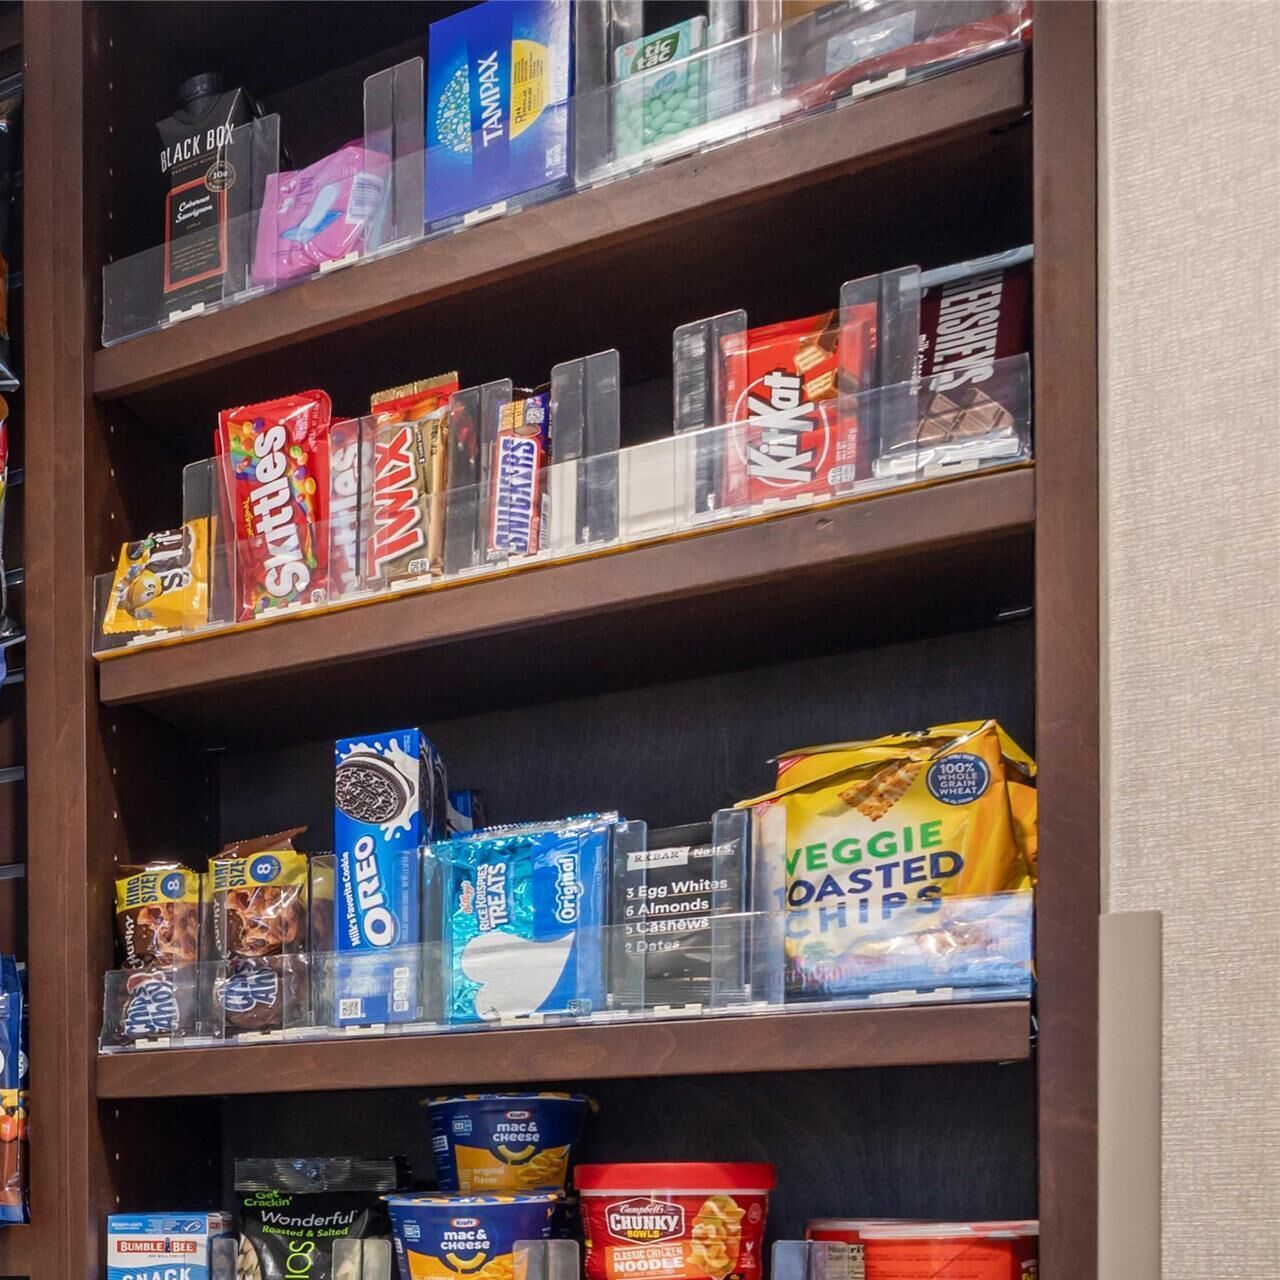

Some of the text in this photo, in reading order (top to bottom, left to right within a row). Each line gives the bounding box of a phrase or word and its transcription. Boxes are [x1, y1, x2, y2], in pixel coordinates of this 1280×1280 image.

[645, 38, 672, 58] tic
[637, 52, 671, 69] tac
[478, 50, 503, 147] TAMPAX
[160, 123, 235, 173] BLACK BOX
[366, 428, 422, 578] TWIX
[509, 440, 536, 554] SNICKERS
[250, 425, 310, 596] Skittles
[938, 772, 977, 781] WHOLE
[939, 763, 974, 774] 100%
[939, 787, 977, 796] WHEAT
[785, 820, 943, 876] VEGGIE
[344, 882, 356, 917] Favorite
[354, 835, 397, 946] OREO
[476, 864, 489, 931] RICE KRISPIES
[488, 863, 506, 927] TREATS
[556, 854, 580, 922] Original
[626, 878, 728, 898] 3 Egg Whites
[626, 898, 709, 917] 6 Almonds
[785, 886, 943, 938] CHIPS
[345, 919, 361, 947] Milk's
[497, 1122, 537, 1132] mac &
[261, 1210, 355, 1227] Wonderful
[610, 1211, 678, 1231] CHUNKY
[627, 1229, 660, 1239] BOWLS
[120, 1241, 193, 1252] BUMBLE BEE
[613, 1256, 684, 1272] NOODLE
